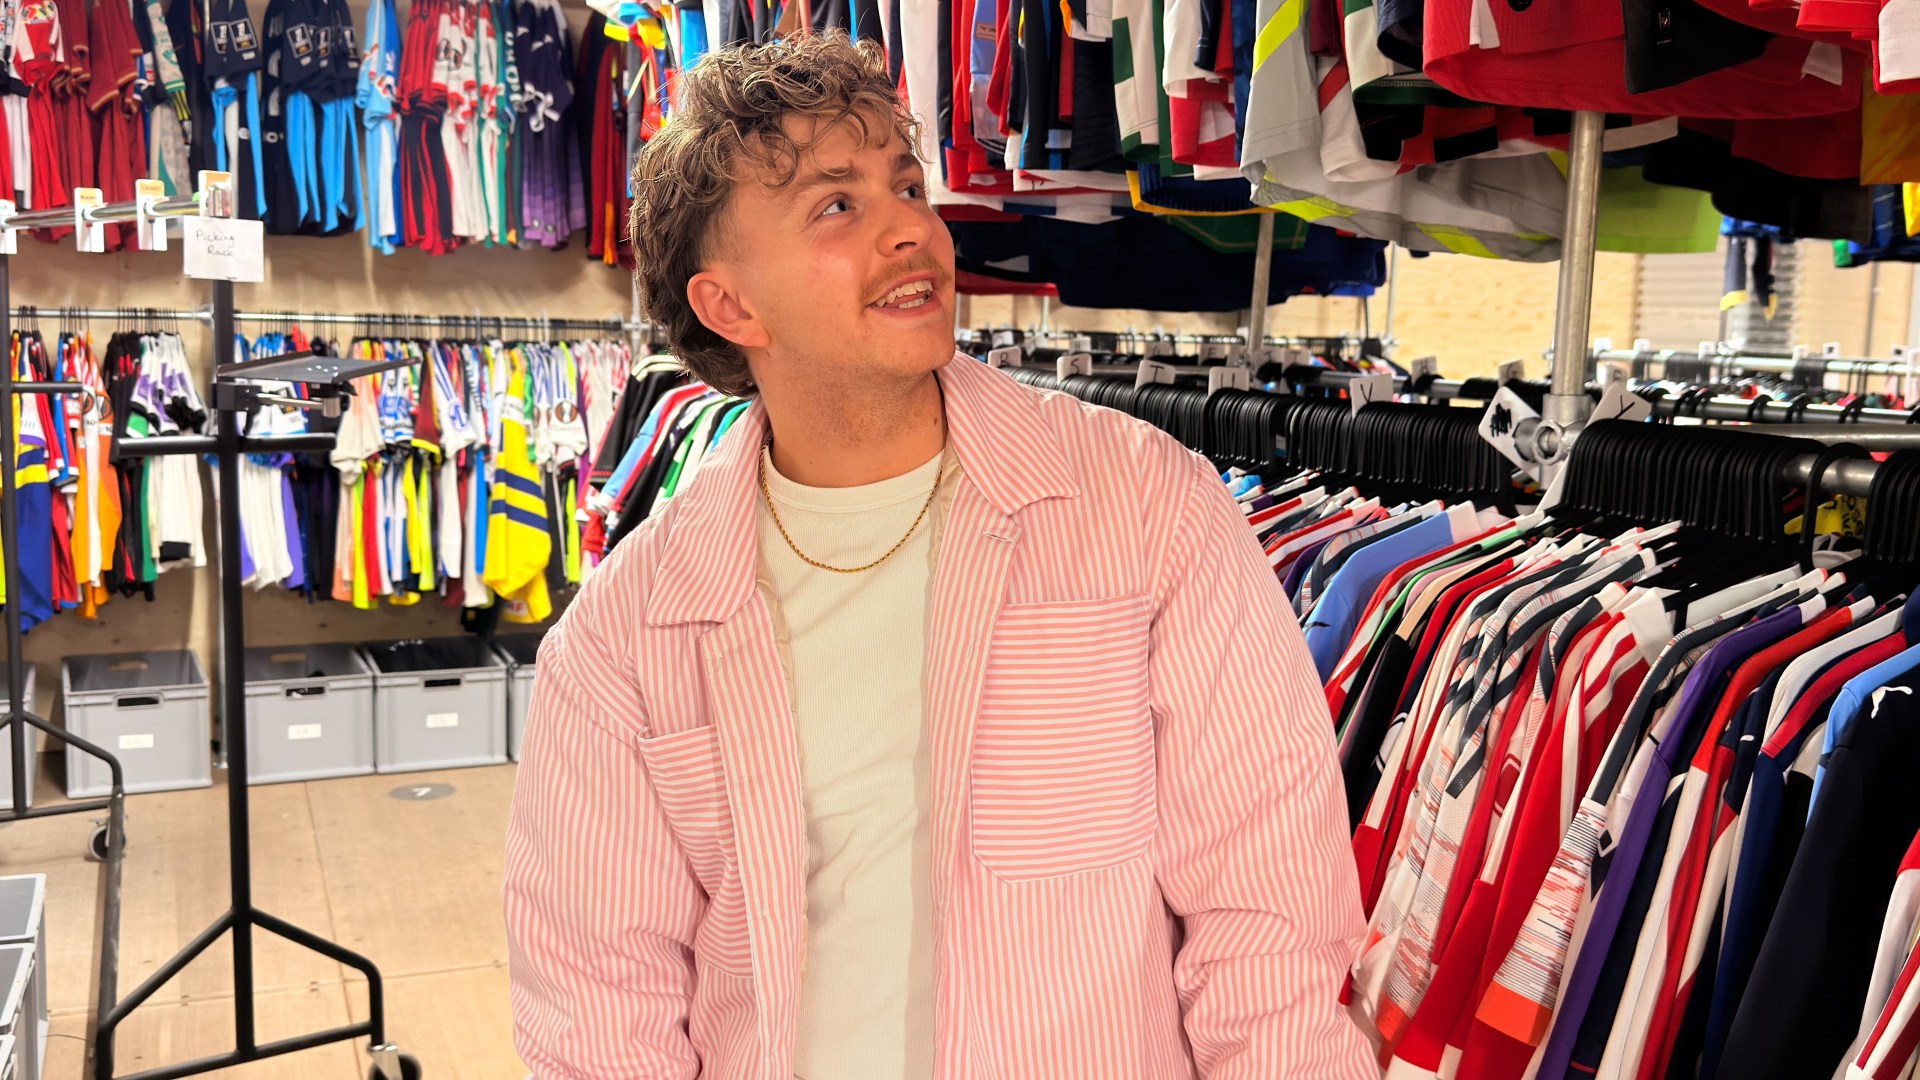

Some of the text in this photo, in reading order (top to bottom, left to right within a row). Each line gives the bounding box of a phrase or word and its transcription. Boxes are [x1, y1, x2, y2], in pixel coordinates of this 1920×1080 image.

[196, 229, 235, 248] Picking
[208, 244, 235, 257] Rack
[1070, 358, 1080, 374] S
[1149, 364, 1165, 383] T
[1613, 394, 1636, 420] Y
